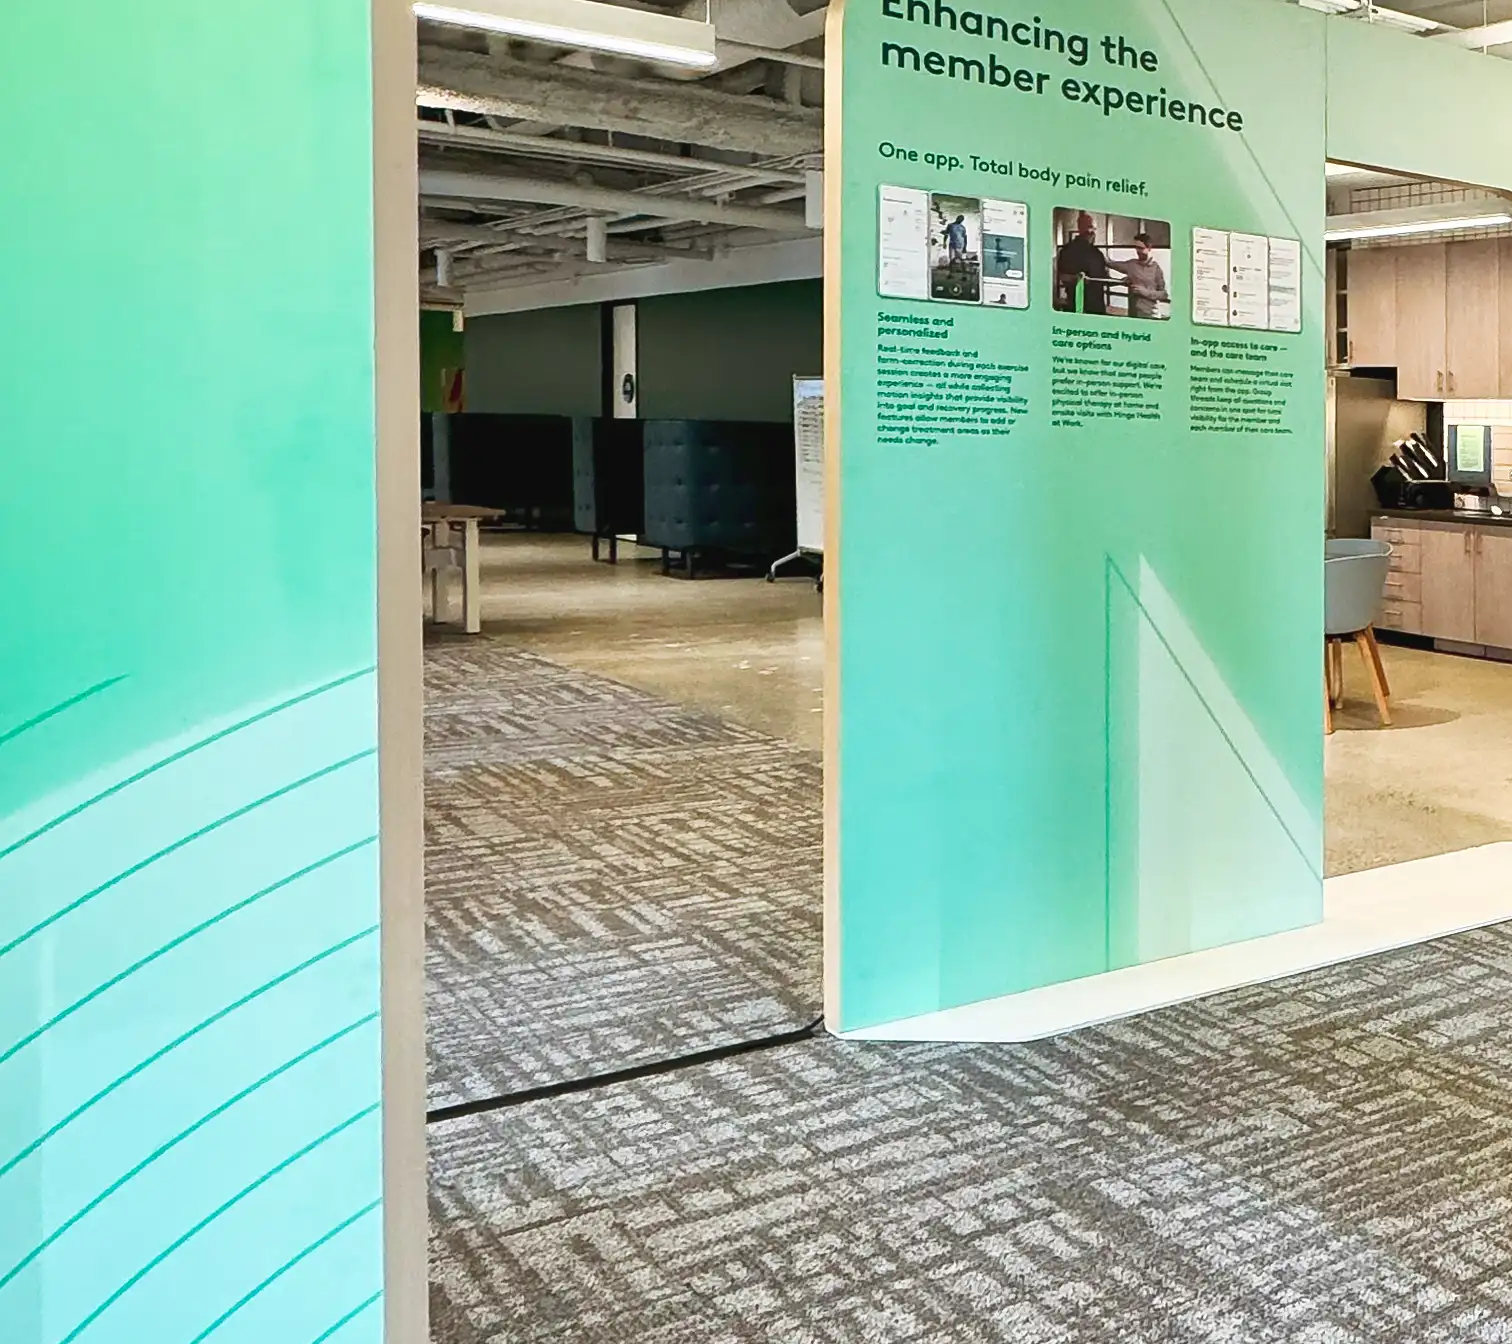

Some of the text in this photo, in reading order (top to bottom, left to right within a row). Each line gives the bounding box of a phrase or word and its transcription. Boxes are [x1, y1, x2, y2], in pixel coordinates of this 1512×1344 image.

[1100, 35, 1158, 72] the
[882, 42, 1243, 132] member experience
[879, 142, 1148, 197] One app. Total body pain relief.
[877, 312, 954, 327] Seamless and
[877, 327, 948, 339] personalized
[1052, 326, 1151, 342] In-person and hybrid
[1052, 340, 1112, 350] care options
[1190, 337, 1219, 349] In-app
[1220, 341, 1248, 349] access
[1260, 344, 1278, 352] care
[1190, 349, 1267, 361] and the care team
